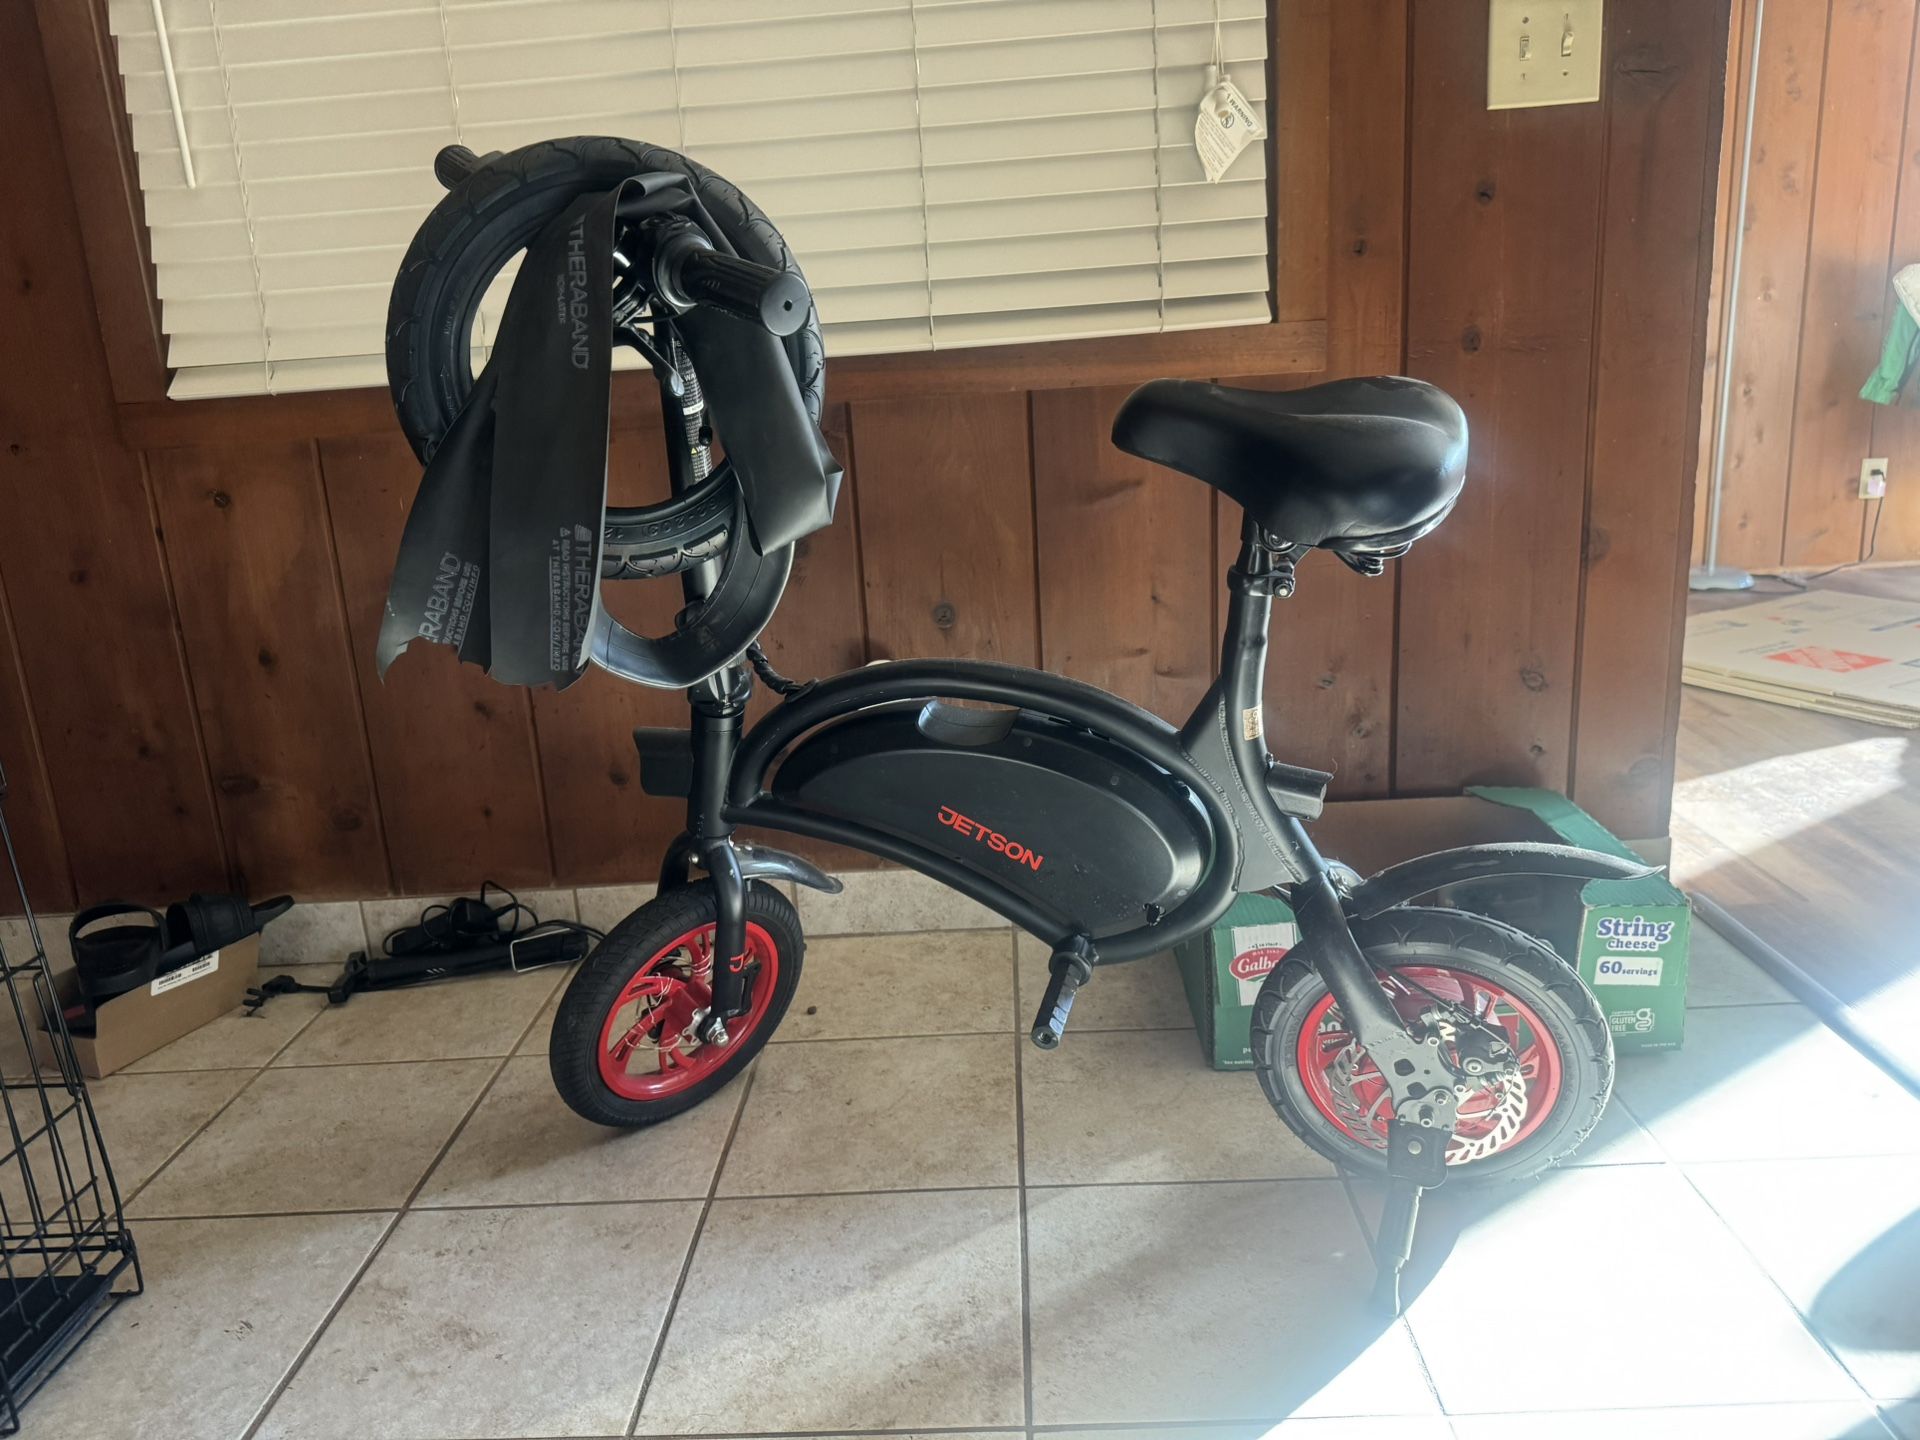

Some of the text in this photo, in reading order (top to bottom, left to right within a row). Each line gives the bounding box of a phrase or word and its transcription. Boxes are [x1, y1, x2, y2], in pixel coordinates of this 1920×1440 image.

[568, 224, 589, 369] THERABAND
[551, 539, 560, 551] AT
[418, 552, 460, 643] RABAND
[561, 562, 570, 621] INSTRUCTIONS
[937, 804, 1044, 872] JETSON
[1597, 916, 1671, 942] String
[1607, 938, 1657, 950] cheese
[1599, 961, 1658, 977] 60 servings
[1611, 1016, 1636, 1025] GLUTEN
